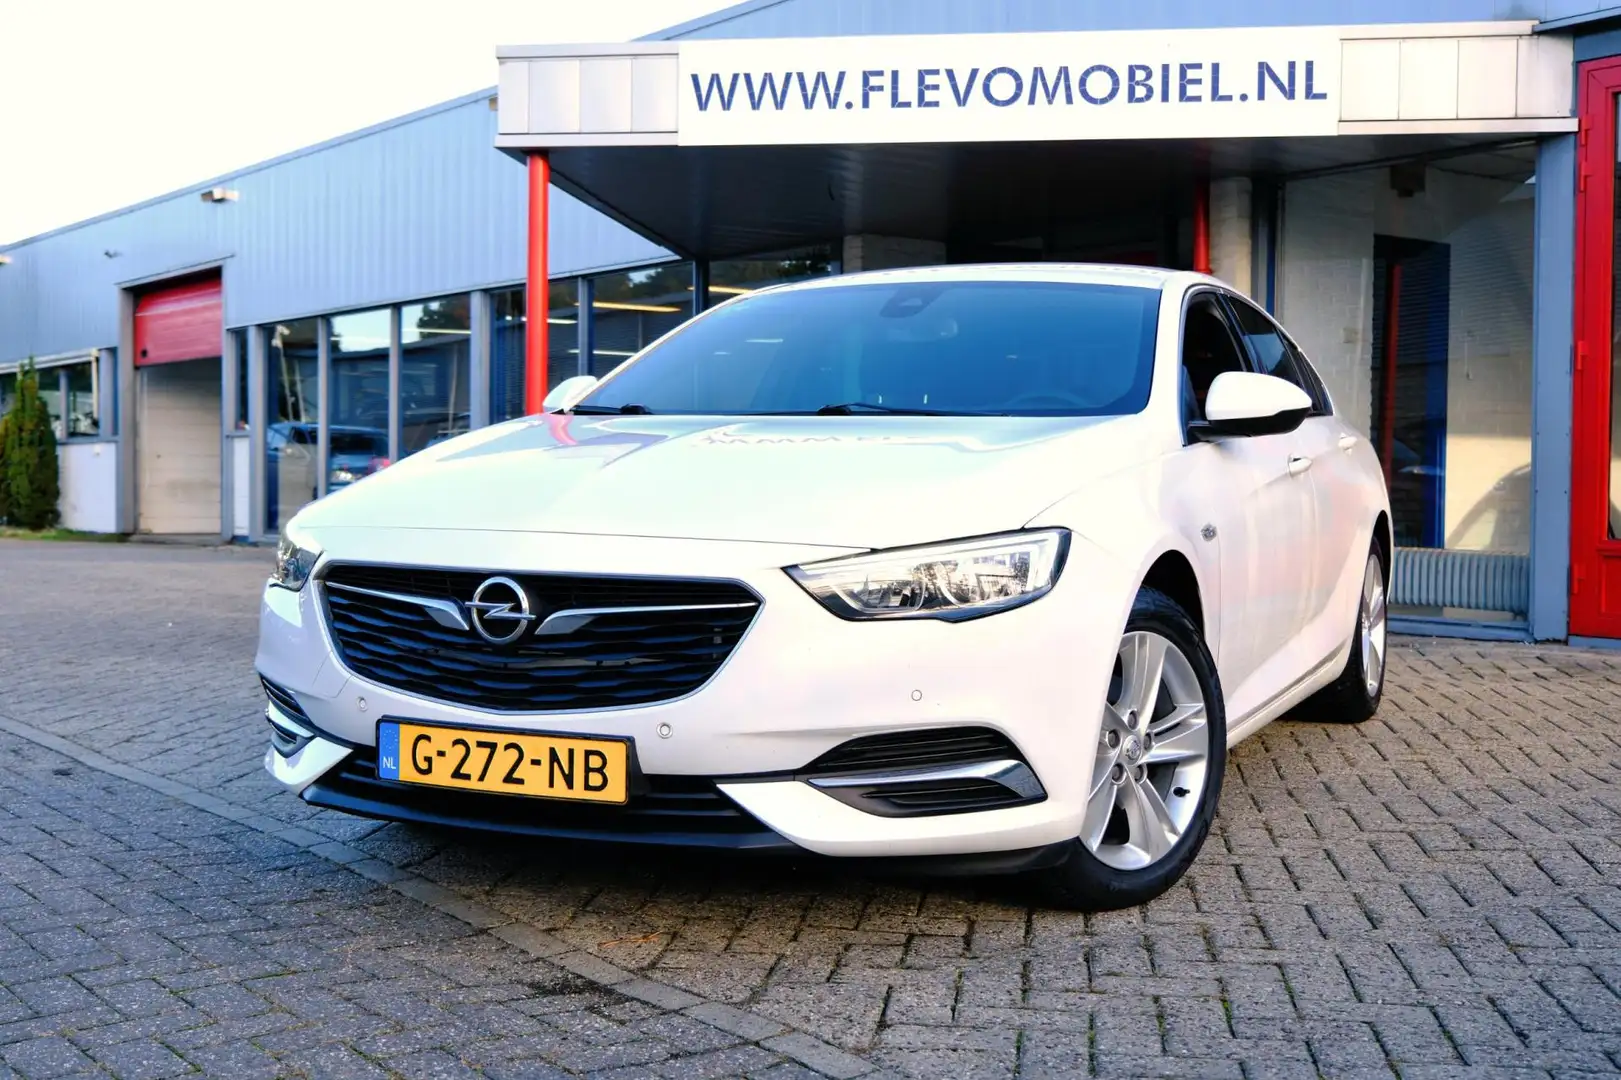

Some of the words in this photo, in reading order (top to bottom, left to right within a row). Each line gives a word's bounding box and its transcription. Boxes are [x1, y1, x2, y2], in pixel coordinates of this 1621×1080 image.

[691, 60, 1328, 111] WWW.FLEVOMOBIEL.NL
[382, 757, 397, 770] NL
[411, 733, 609, 792] G-272-NB
